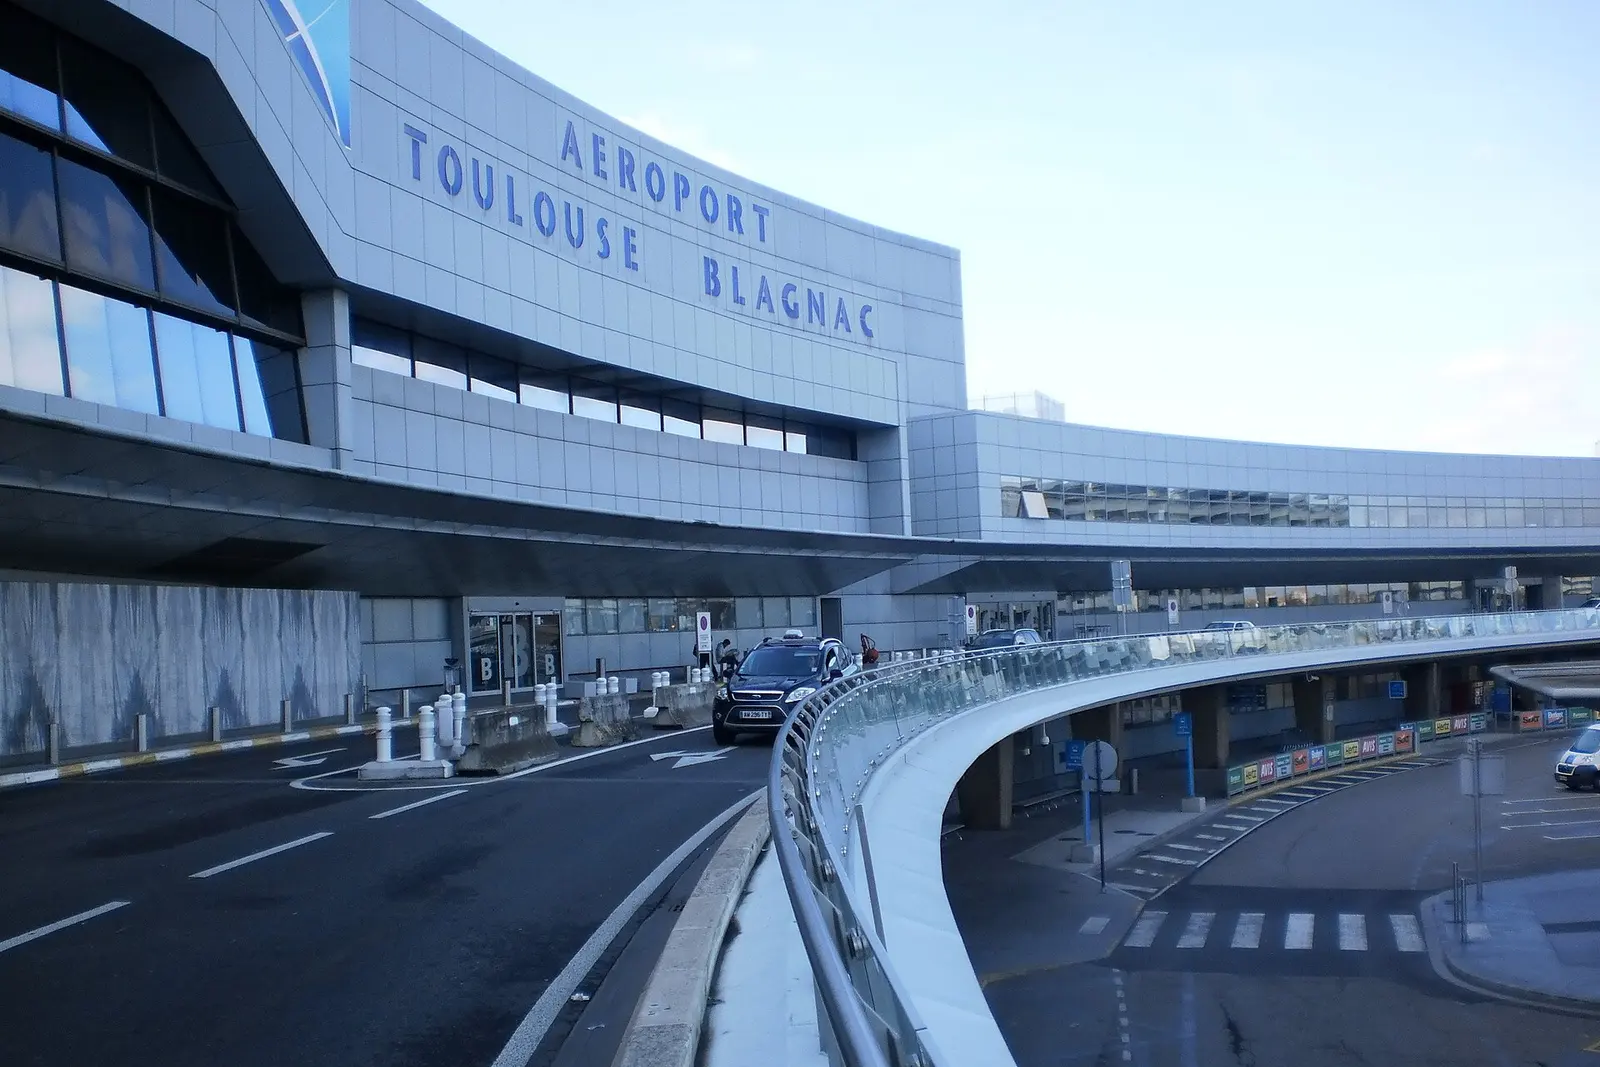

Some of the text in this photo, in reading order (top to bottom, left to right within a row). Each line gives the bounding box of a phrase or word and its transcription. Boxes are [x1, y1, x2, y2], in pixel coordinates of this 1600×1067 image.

[560, 119, 769, 243] AEROPORT
[403, 122, 639, 271] TOULOUSE
[703, 255, 875, 339] BLAGNAC
[503, 624, 529, 678] B
[481, 657, 492, 681] B
[545, 653, 555, 675] B
[1454, 718, 1467, 730] AVIS
[1362, 740, 1375, 753] AVIS
[1261, 762, 1274, 778] AVIS
